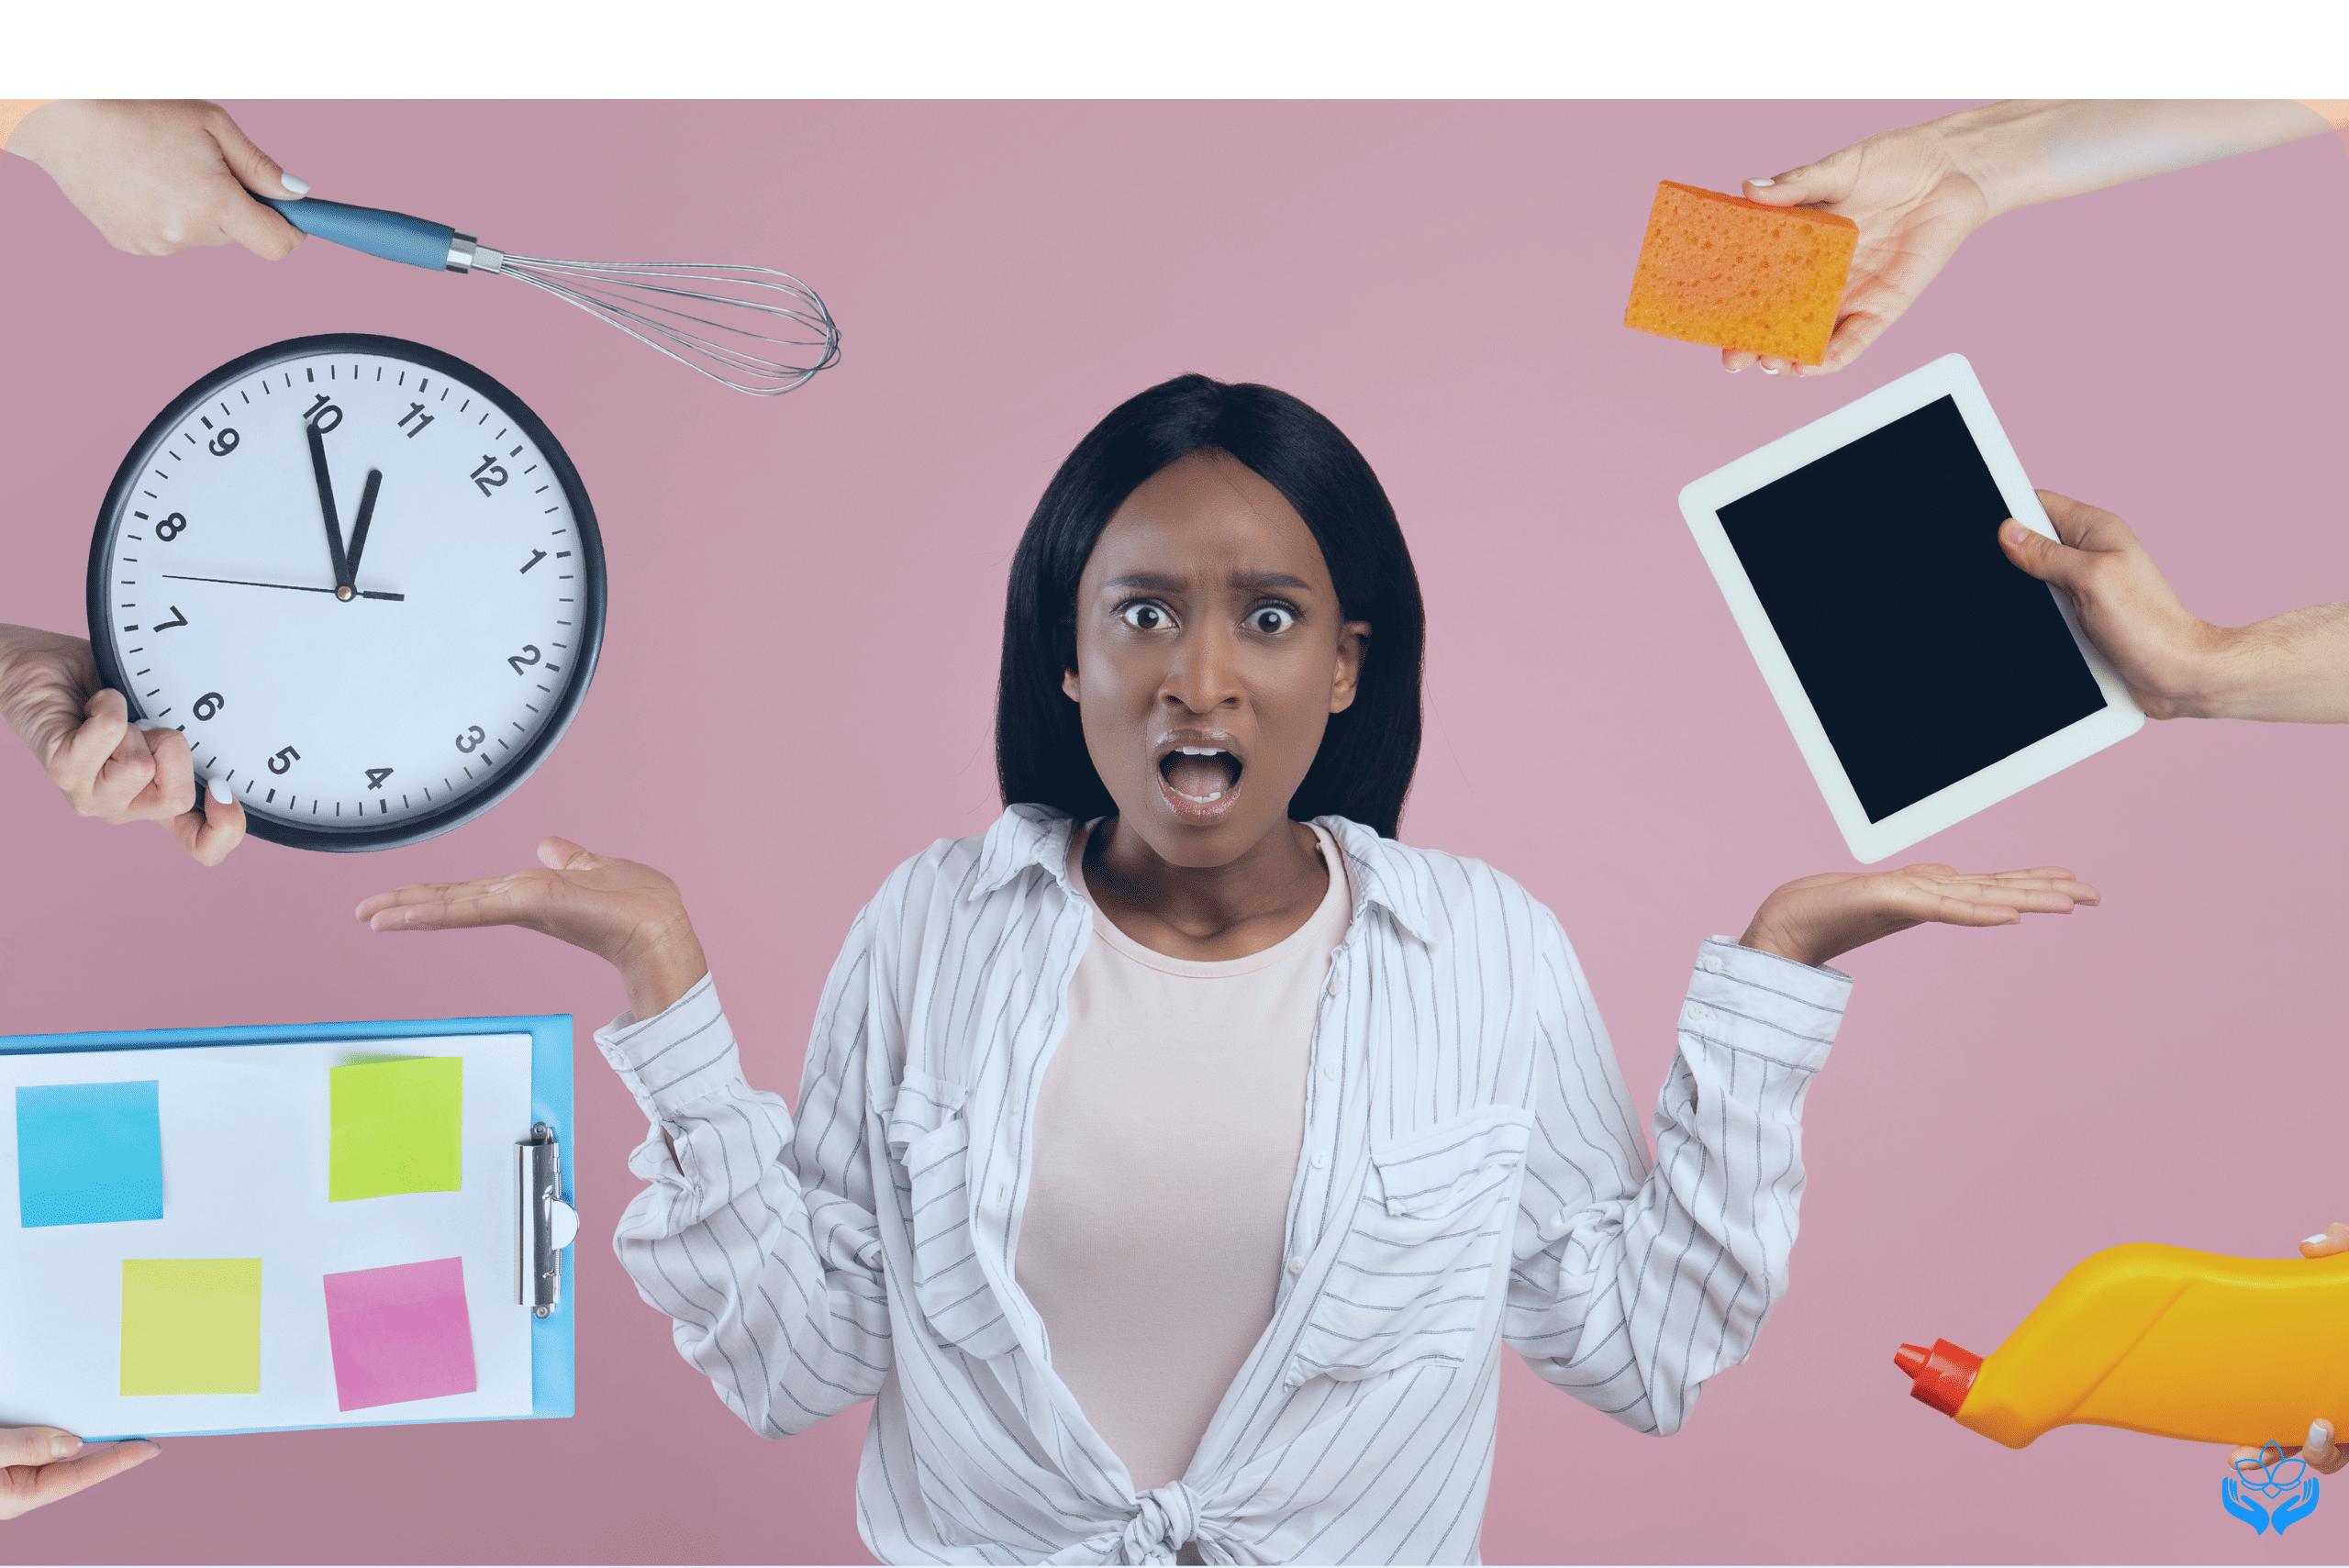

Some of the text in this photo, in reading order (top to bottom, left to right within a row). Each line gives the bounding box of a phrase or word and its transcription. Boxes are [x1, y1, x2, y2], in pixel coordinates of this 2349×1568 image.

[303, 394, 343, 434] 10
[398, 403, 434, 438] 11
[208, 428, 239, 456] 9
[471, 454, 508, 496] 12
[156, 513, 186, 541] 8
[520, 550, 547, 573] 1
[153, 606, 188, 632] 7
[508, 645, 540, 675] 2
[193, 692, 224, 721] 6
[456, 726, 486, 755] 3
[268, 746, 300, 774] 5
[365, 768, 394, 790] 4
